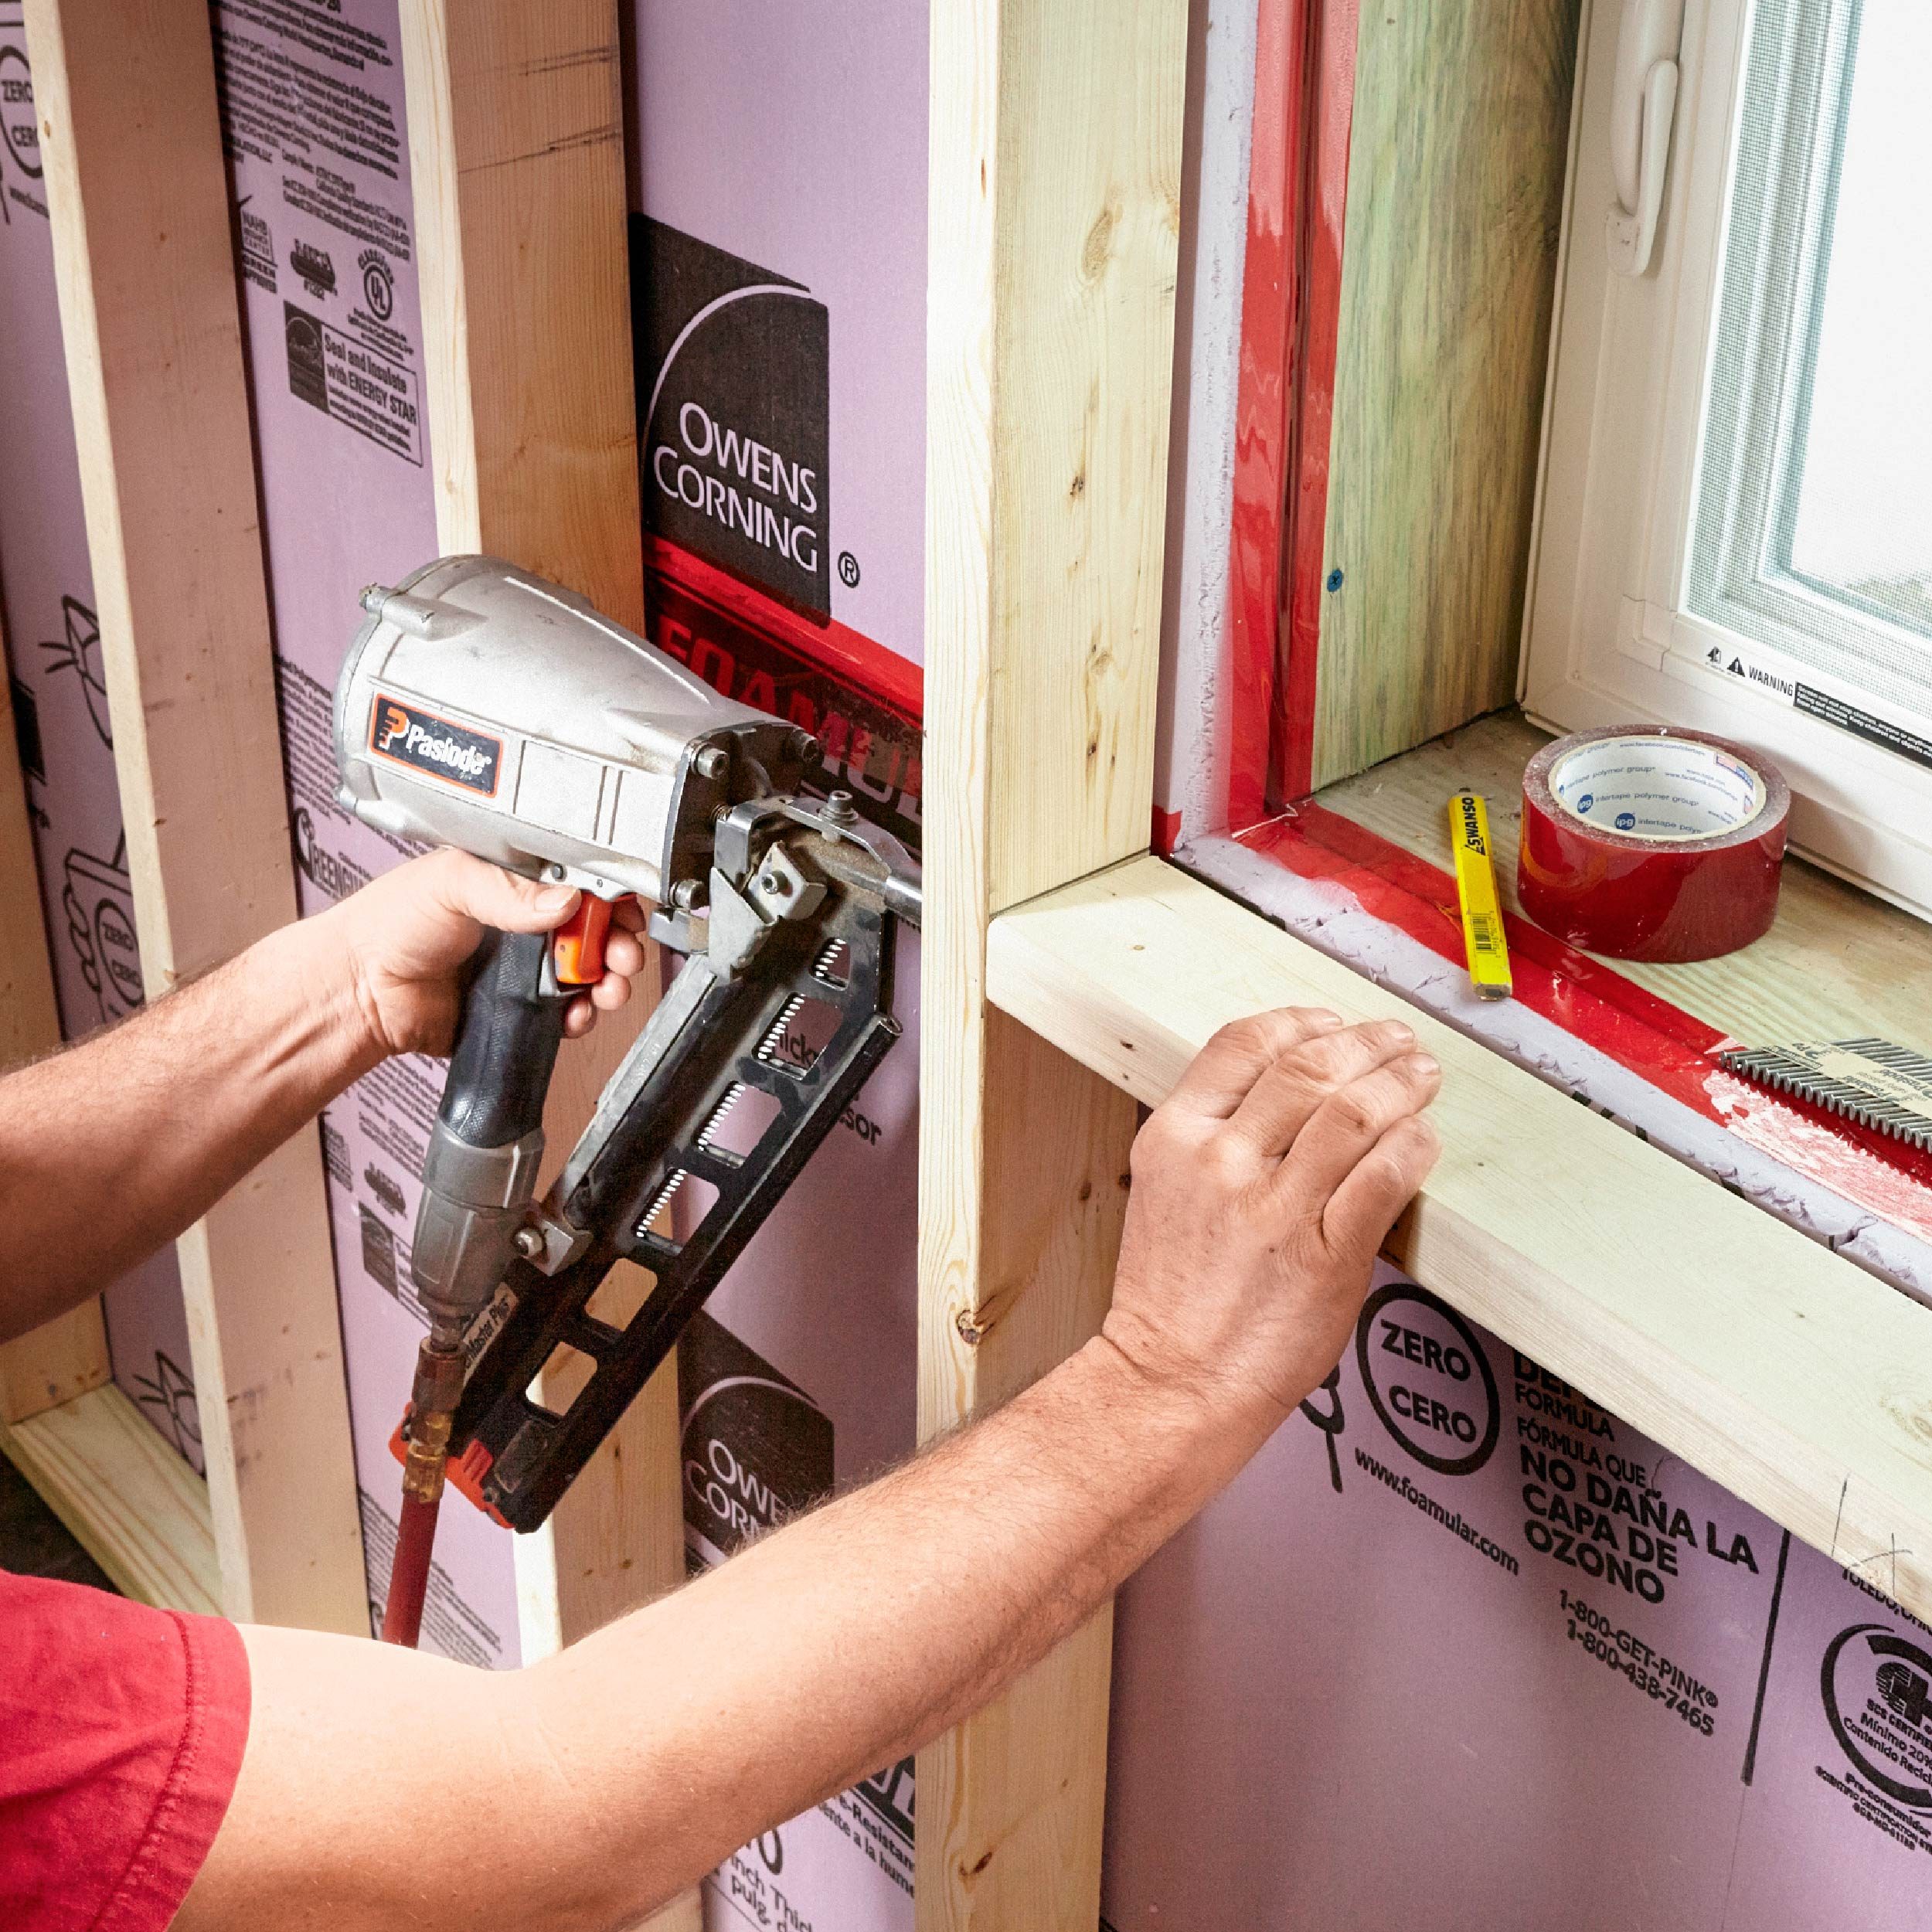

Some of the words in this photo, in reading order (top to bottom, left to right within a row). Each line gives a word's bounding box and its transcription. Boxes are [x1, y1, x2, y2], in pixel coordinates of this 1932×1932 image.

[12, 125, 39, 147] CER
[325, 333, 345, 361] Seal
[348, 370, 388, 408] ENERGY
[389, 395, 417, 426] STAR
[680, 402, 818, 513] OWENS
[653, 445, 818, 572] CORNING
[1749, 665, 1794, 696] WARNING
[1379, 1318, 1471, 1381] ZERO
[1388, 1386, 1477, 1443] CERO
[1515, 1382, 1614, 1442] FORMULA
[1517, 1416, 1602, 1470] FÓRMULA
[1605, 1454, 1646, 1488] QUE
[1354, 1447, 1519, 1576] www.foamular.com
[1520, 1444, 1577, 1492] NO
[1587, 1471, 1698, 1549] DAÑA
[1706, 1520, 1760, 1574] LA
[1522, 1483, 1620, 1550] CAPA
[1628, 1526, 1679, 1577] DE
[1524, 1519, 1665, 1604] OZONO
[1567, 1618, 1715, 1736] 1-800-438-7465
[1844, 1716, 1899, 1762] Contenido
[853, 1831, 862, 1849] a
[865, 1837, 877, 1862] la
